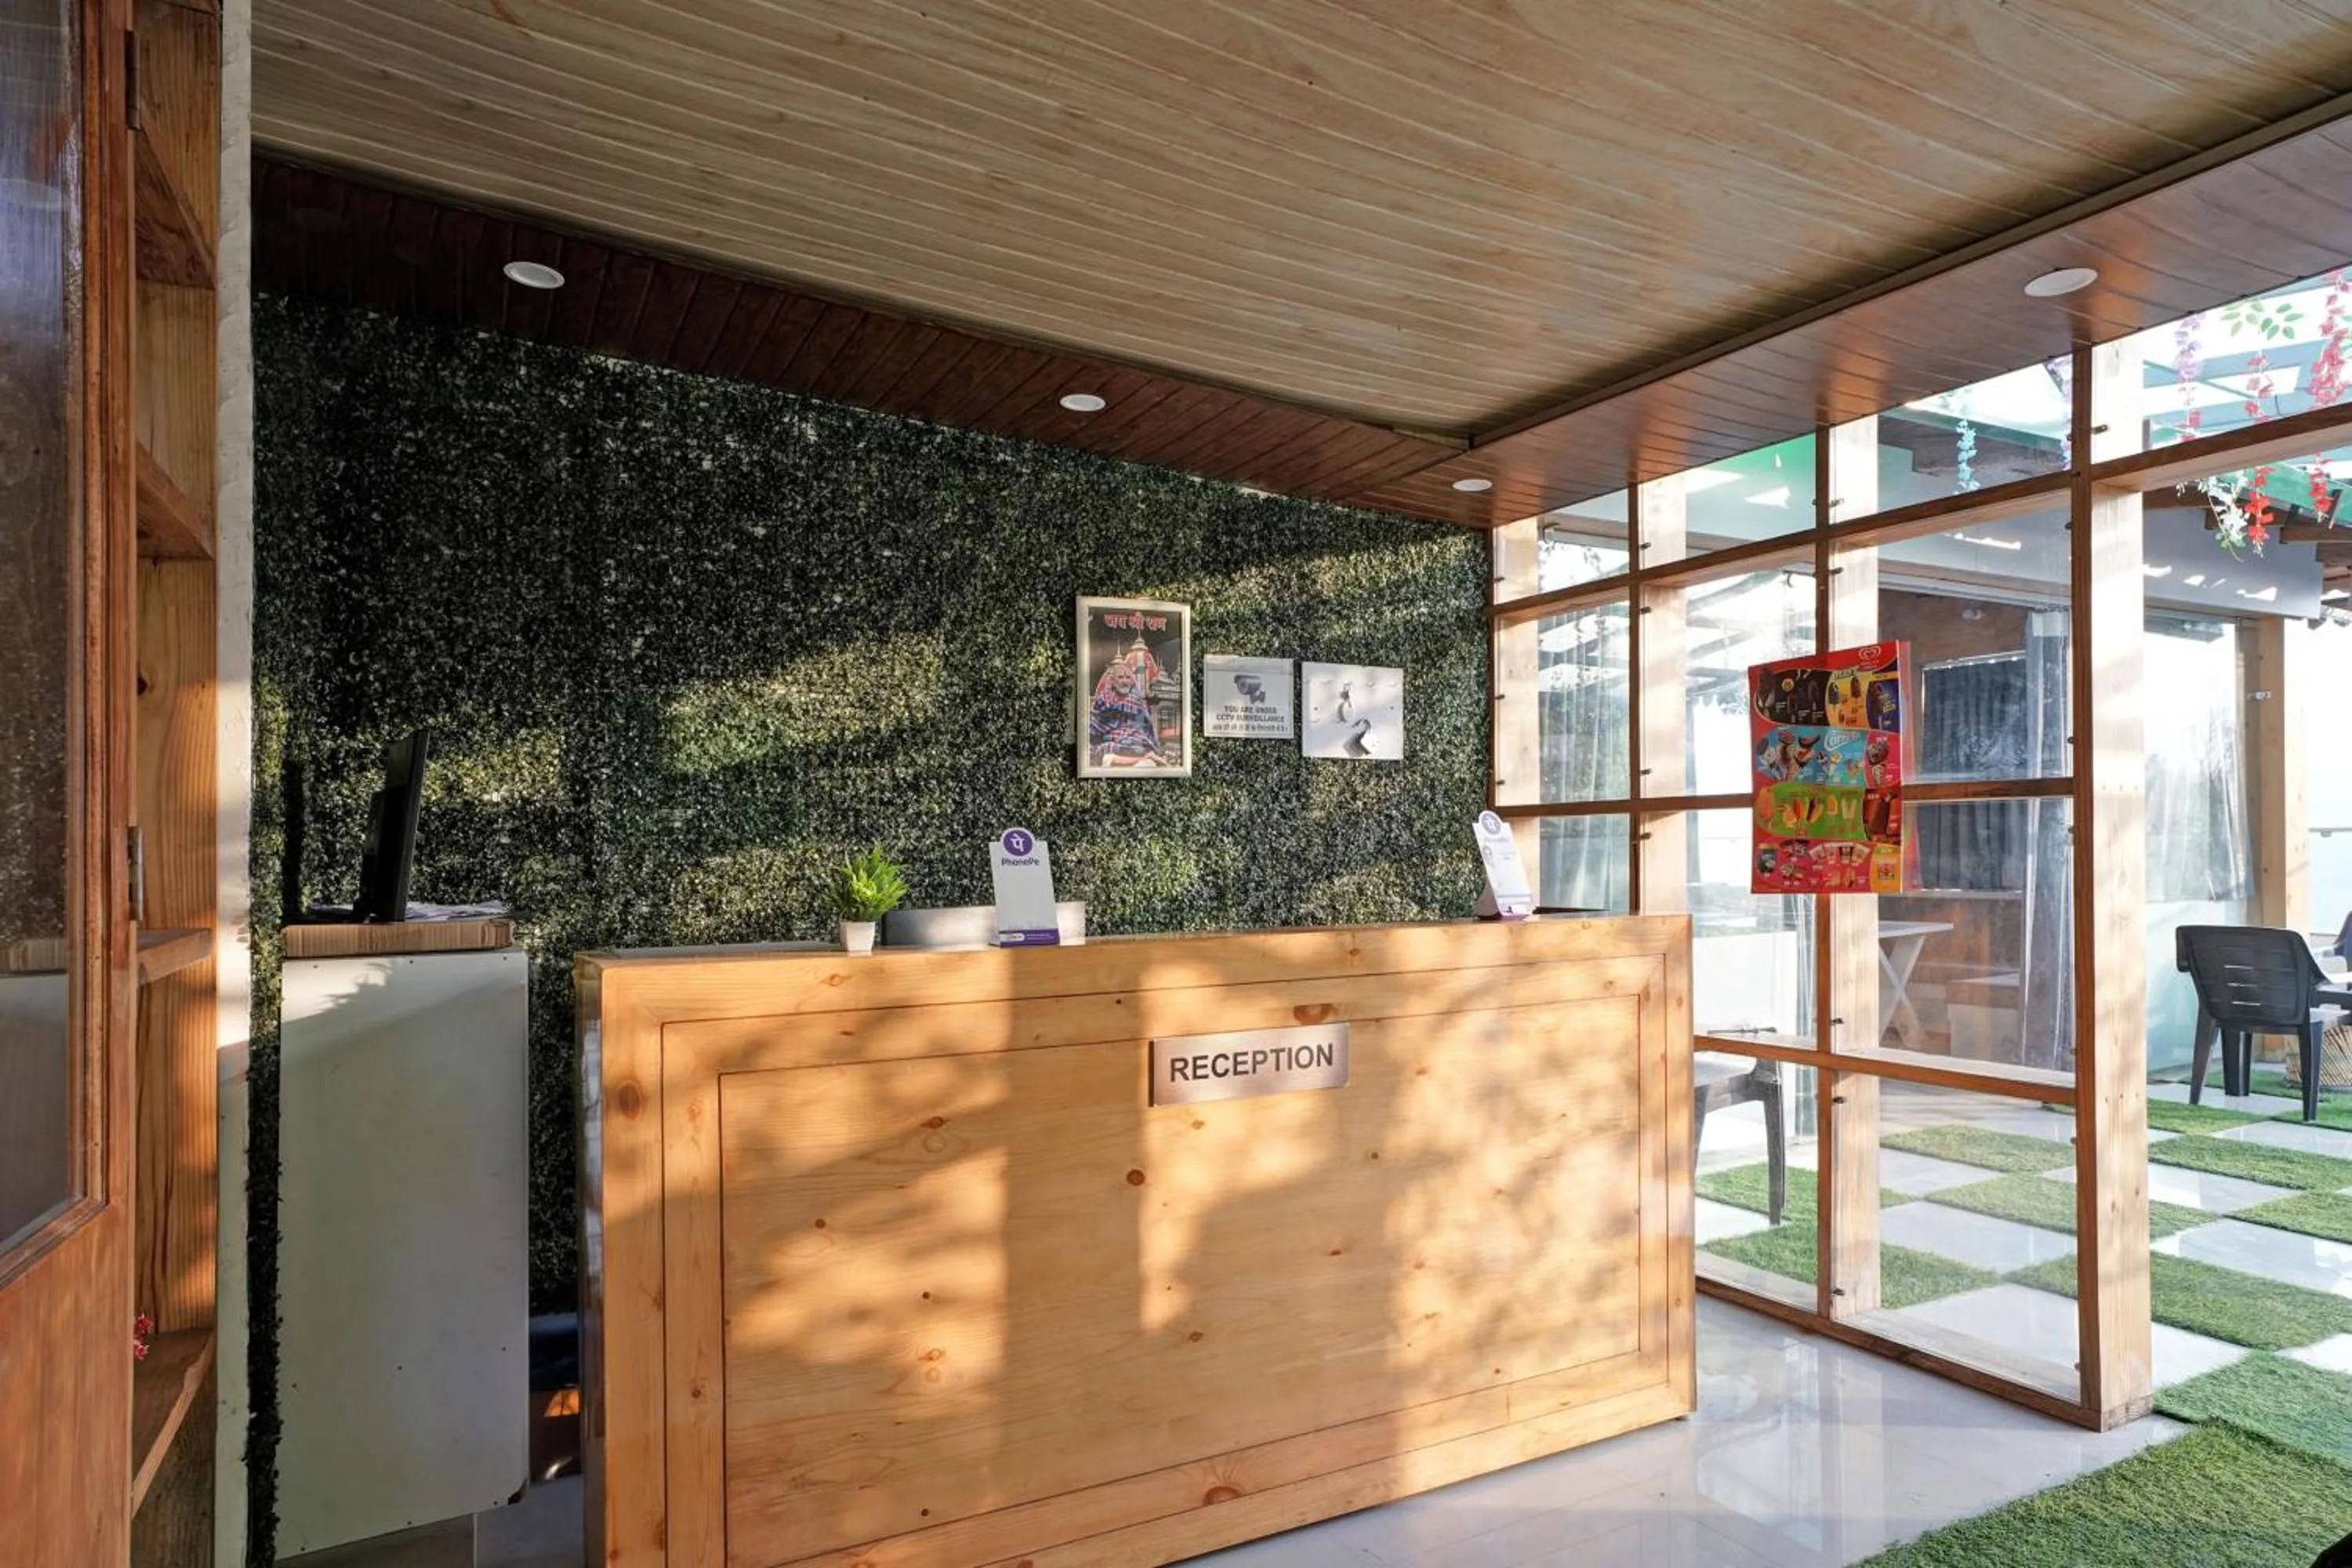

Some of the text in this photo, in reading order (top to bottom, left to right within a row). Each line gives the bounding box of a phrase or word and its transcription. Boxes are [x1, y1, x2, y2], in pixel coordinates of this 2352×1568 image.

[1010, 833, 1025, 852] पे
[1001, 857, 1040, 866] PhonePe
[1170, 1043, 1334, 1082] RECEPTION
